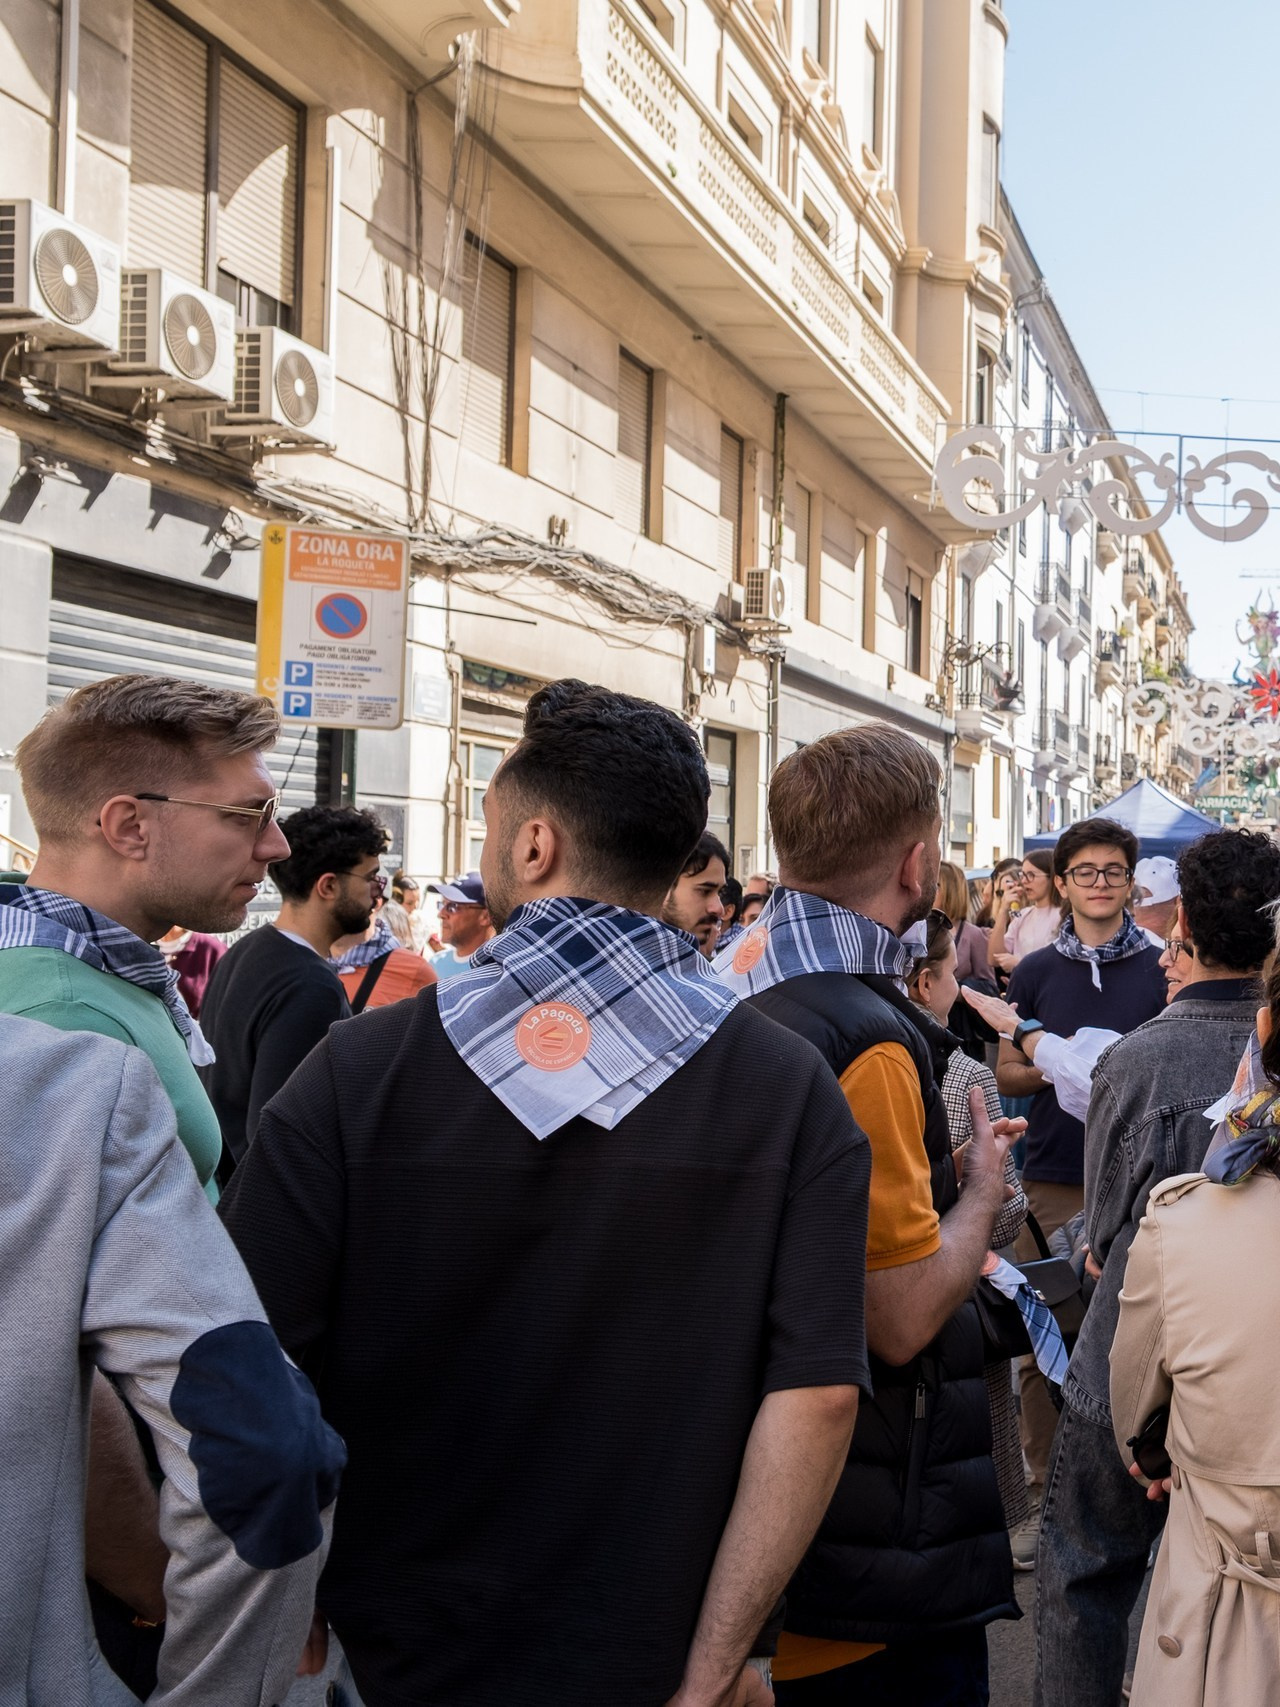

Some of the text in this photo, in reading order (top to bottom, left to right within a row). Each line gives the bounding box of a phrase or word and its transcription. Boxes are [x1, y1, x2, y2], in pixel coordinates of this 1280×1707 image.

[298, 536, 396, 562] ZONA ORA
[316, 556, 375, 571] LA ROQUETA
[299, 643, 377, 655] PAGAMENT OBLIGATORI
[306, 651, 371, 662] PAGO OBLIGATORIO
[290, 664, 307, 683] P
[289, 694, 306, 714] P
[1195, 797, 1248, 809] FARMACIA
[524, 1008, 584, 1034] La Pagoda
[526, 1046, 545, 1065] ESCUELA
